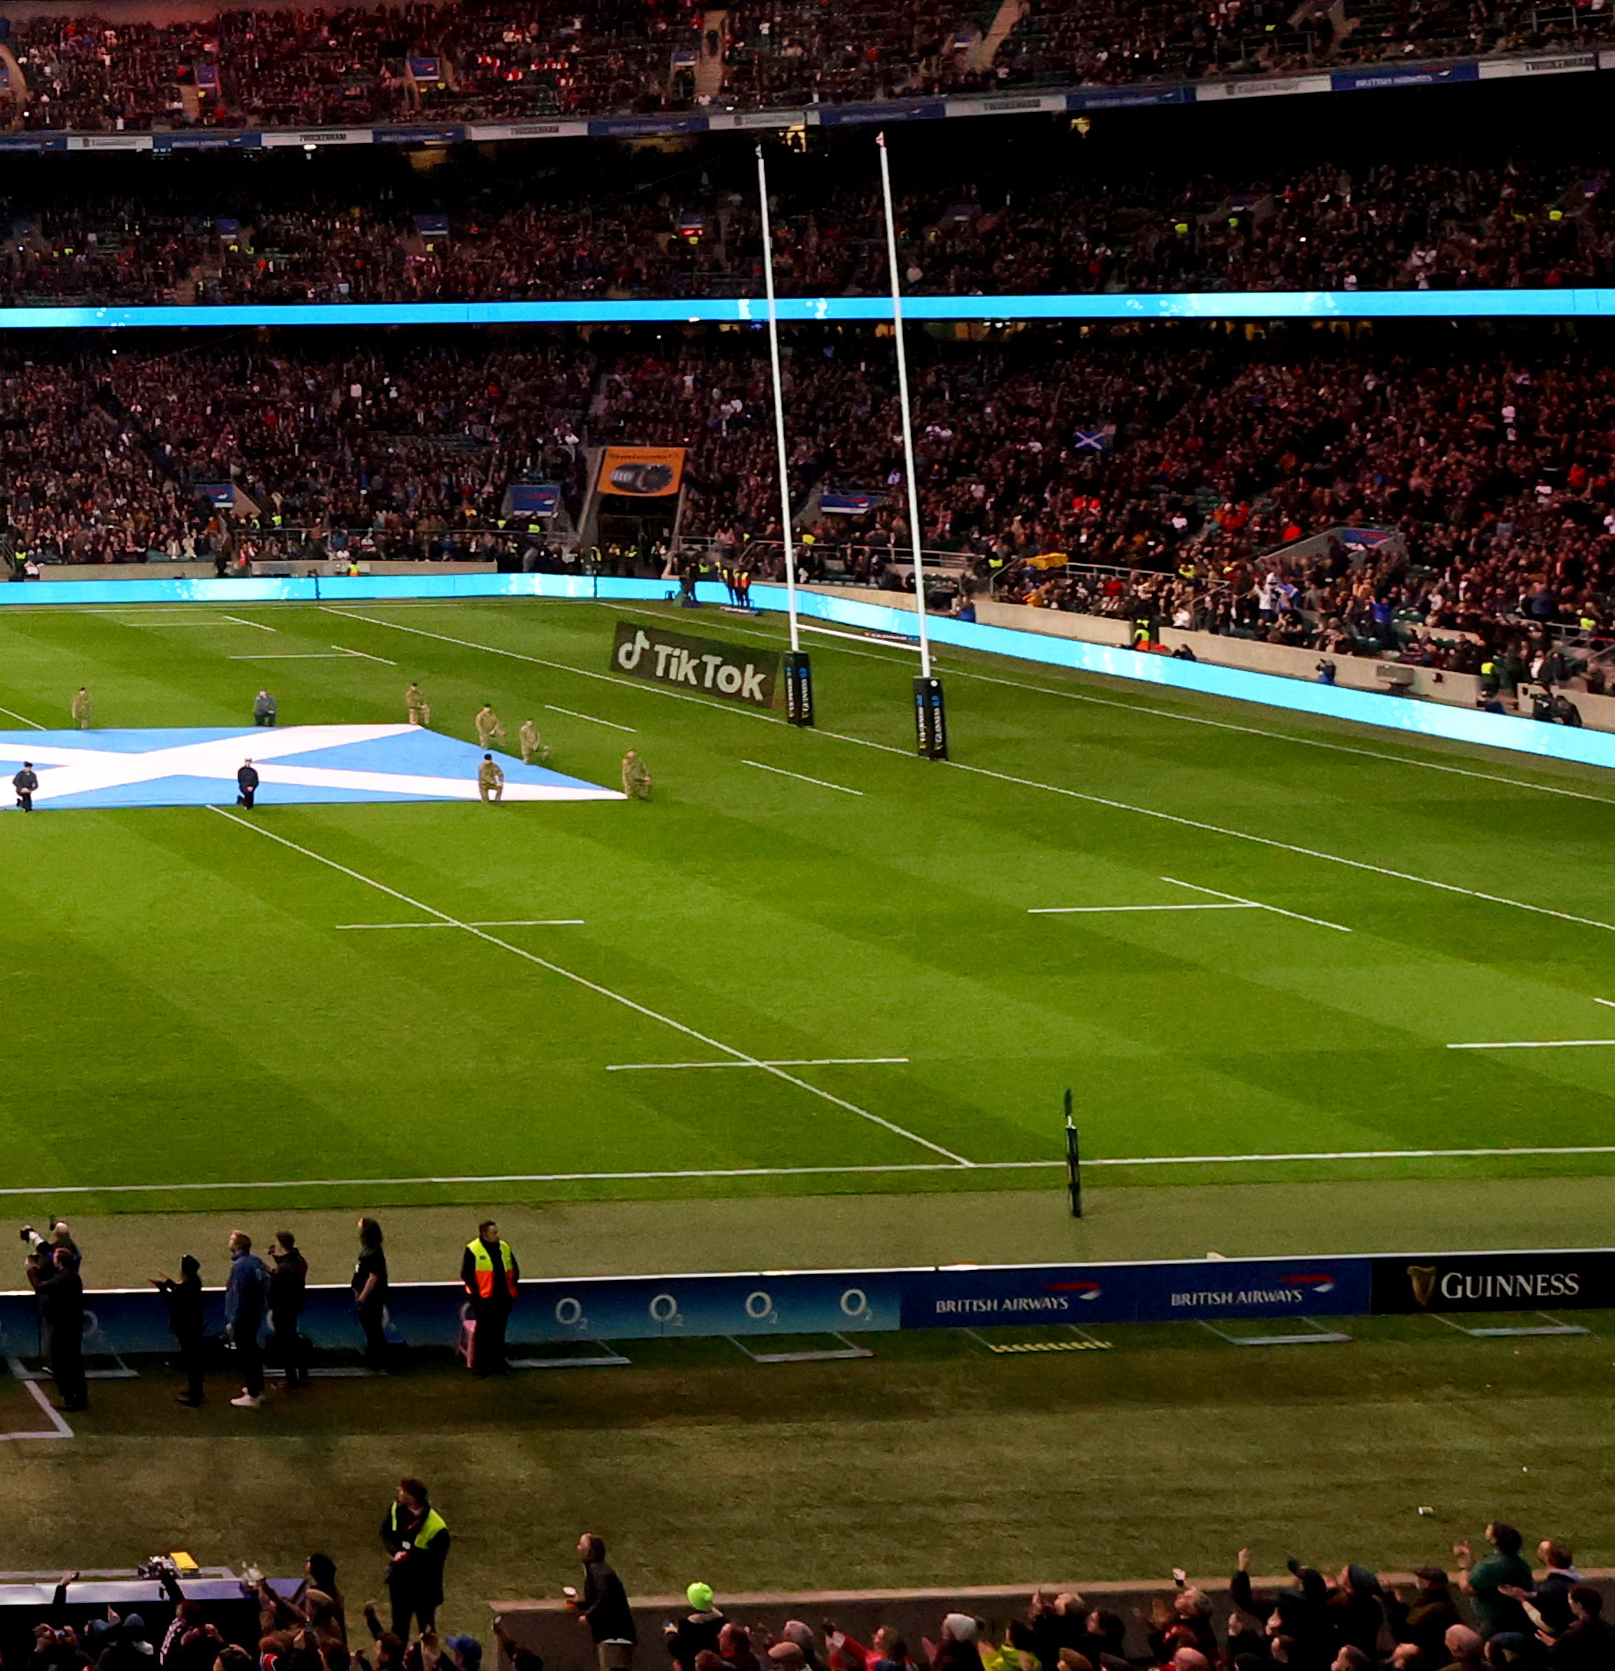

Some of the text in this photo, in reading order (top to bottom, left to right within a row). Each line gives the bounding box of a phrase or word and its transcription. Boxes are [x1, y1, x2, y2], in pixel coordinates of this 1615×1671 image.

[654, 644, 766, 701] TikTok
[1441, 1272, 1580, 1298] GUINNESS
[936, 1296, 1069, 1313] BRITISH AIRWAYS
[1171, 1289, 1303, 1306] BRITISH AIRWAYS
